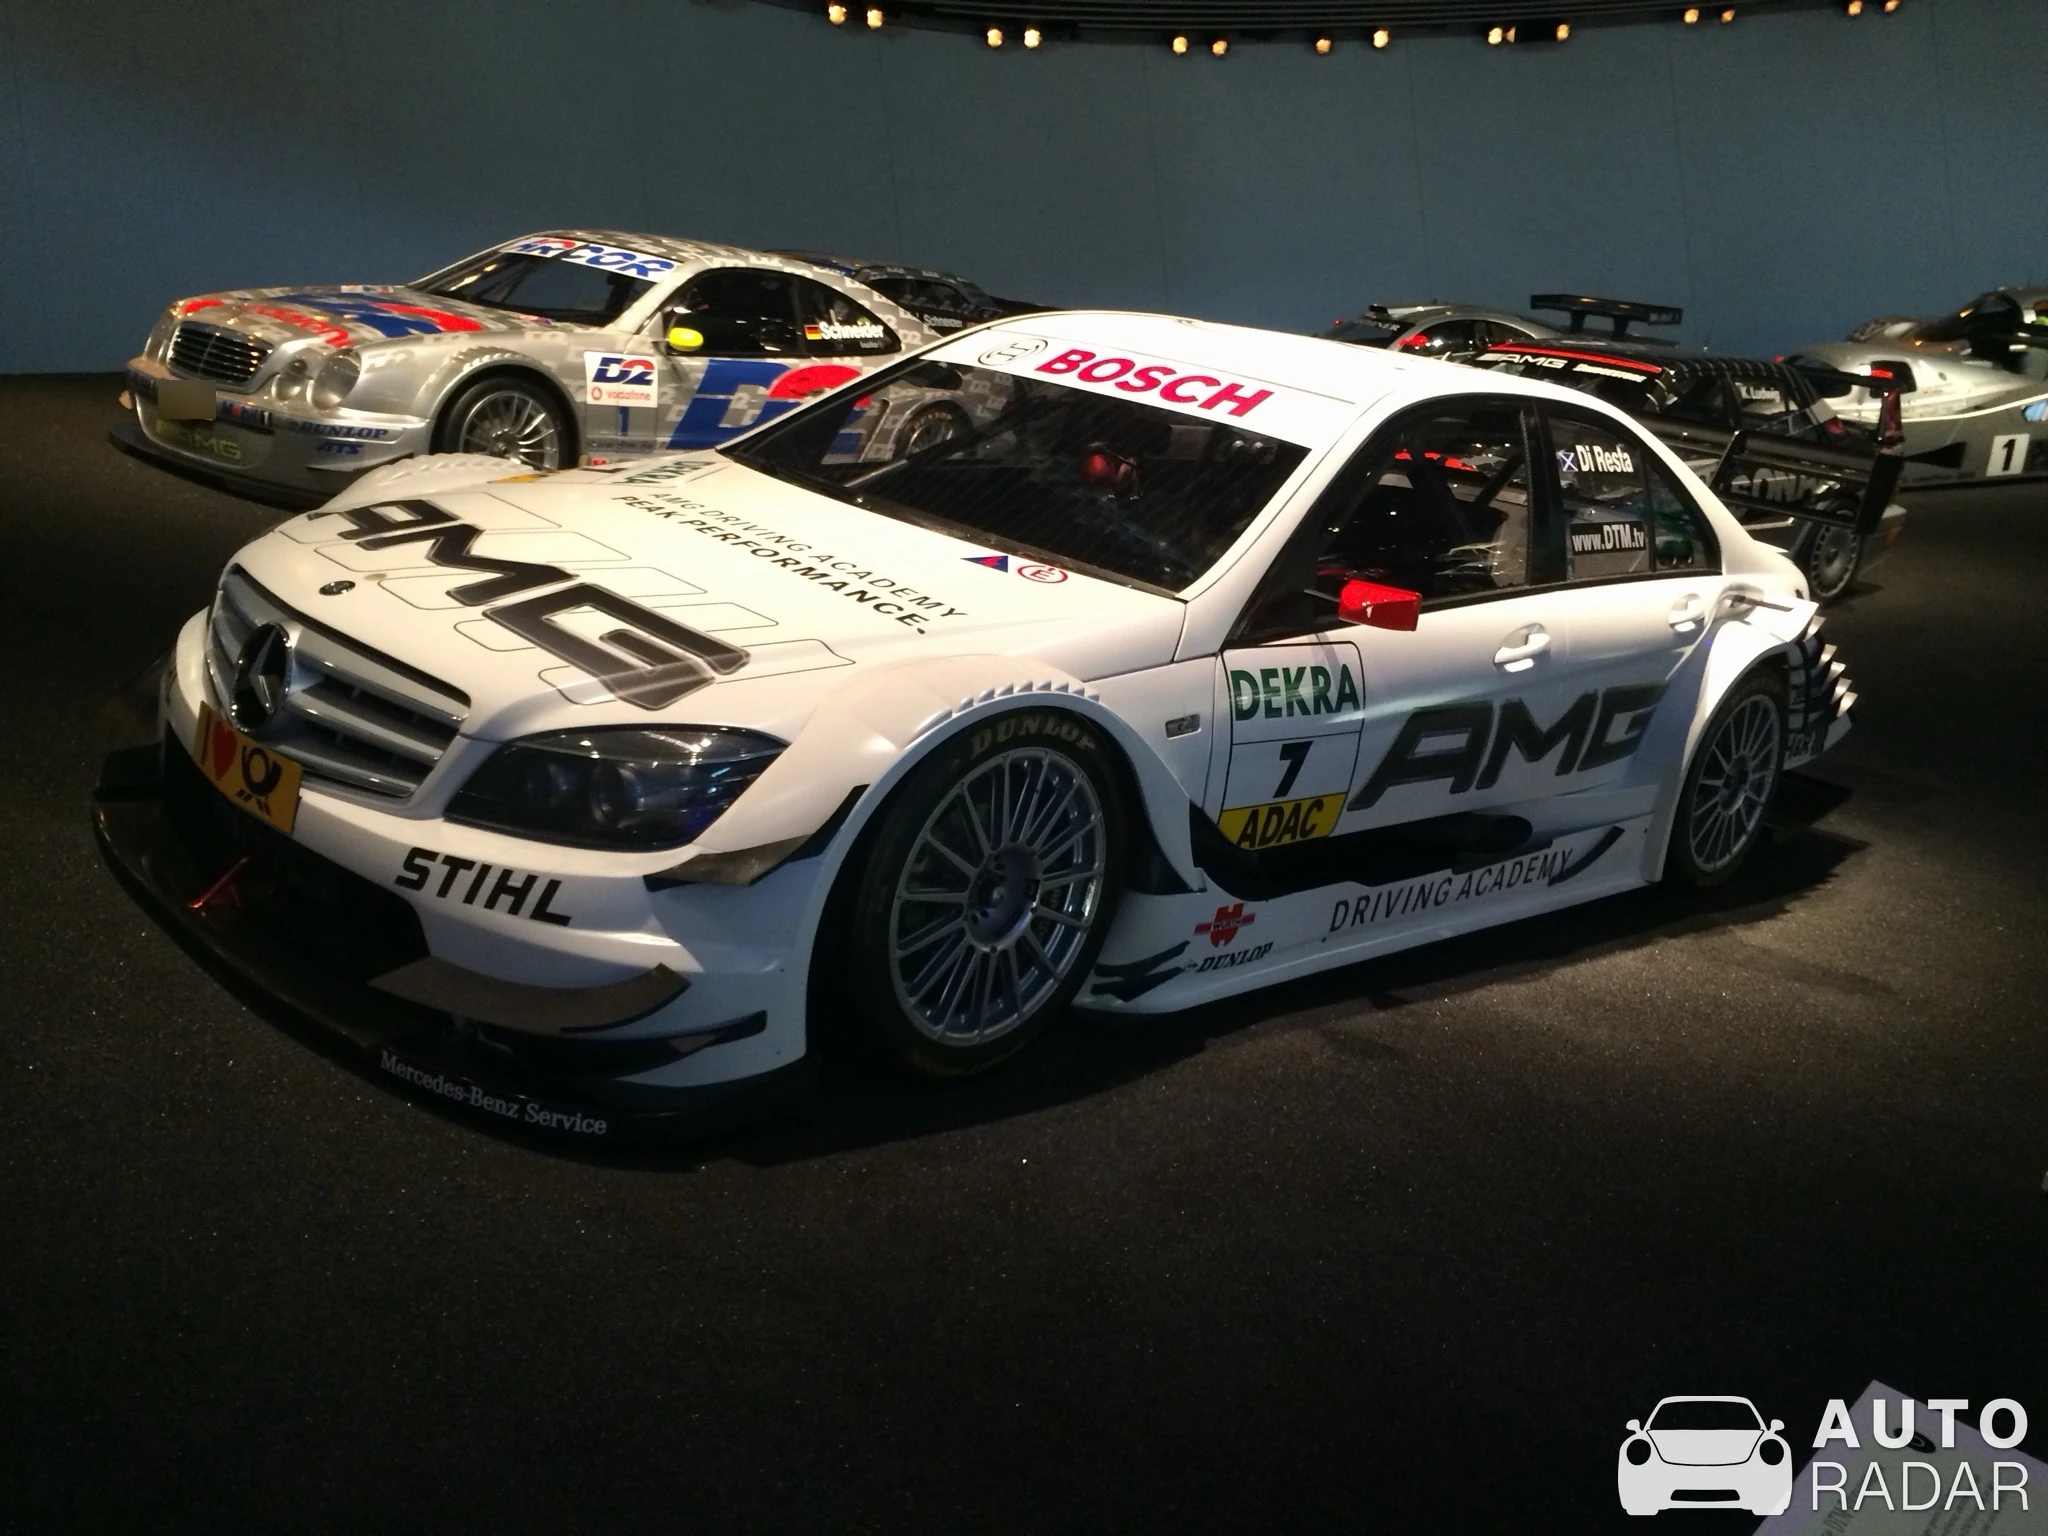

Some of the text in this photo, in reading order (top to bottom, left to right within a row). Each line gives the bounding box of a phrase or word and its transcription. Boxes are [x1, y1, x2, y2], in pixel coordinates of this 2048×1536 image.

[819, 322, 884, 340] Schneider
[592, 357, 655, 386] D2
[1035, 347, 1275, 418] BOSCH
[1499, 354, 1568, 369] AMG
[606, 389, 651, 401] vodafone
[298, 420, 389, 440] DUNLOP
[619, 406, 630, 437] 1
[1575, 444, 1635, 473] Di Resta
[2002, 438, 2017, 471] 1
[648, 493, 968, 619] AMG DRIVING ACADEMY
[1572, 524, 1645, 552] www.DTM.tv
[612, 496, 931, 635] PEAK PERFORMANCE.
[307, 499, 750, 708] AMG
[1230, 663, 1361, 721] DEKRA
[969, 714, 1097, 760] DUNLOP
[1346, 684, 1670, 812] AMG
[1274, 740, 1315, 799] 7
[1235, 798, 1325, 851] ADAC
[394, 846, 574, 927] STIHL
[1329, 847, 1574, 933] DRIVING ACADEMY
[1195, 941, 1274, 973] DUNLOP
[379, 1050, 608, 1135] Mercedes-Benz Service
